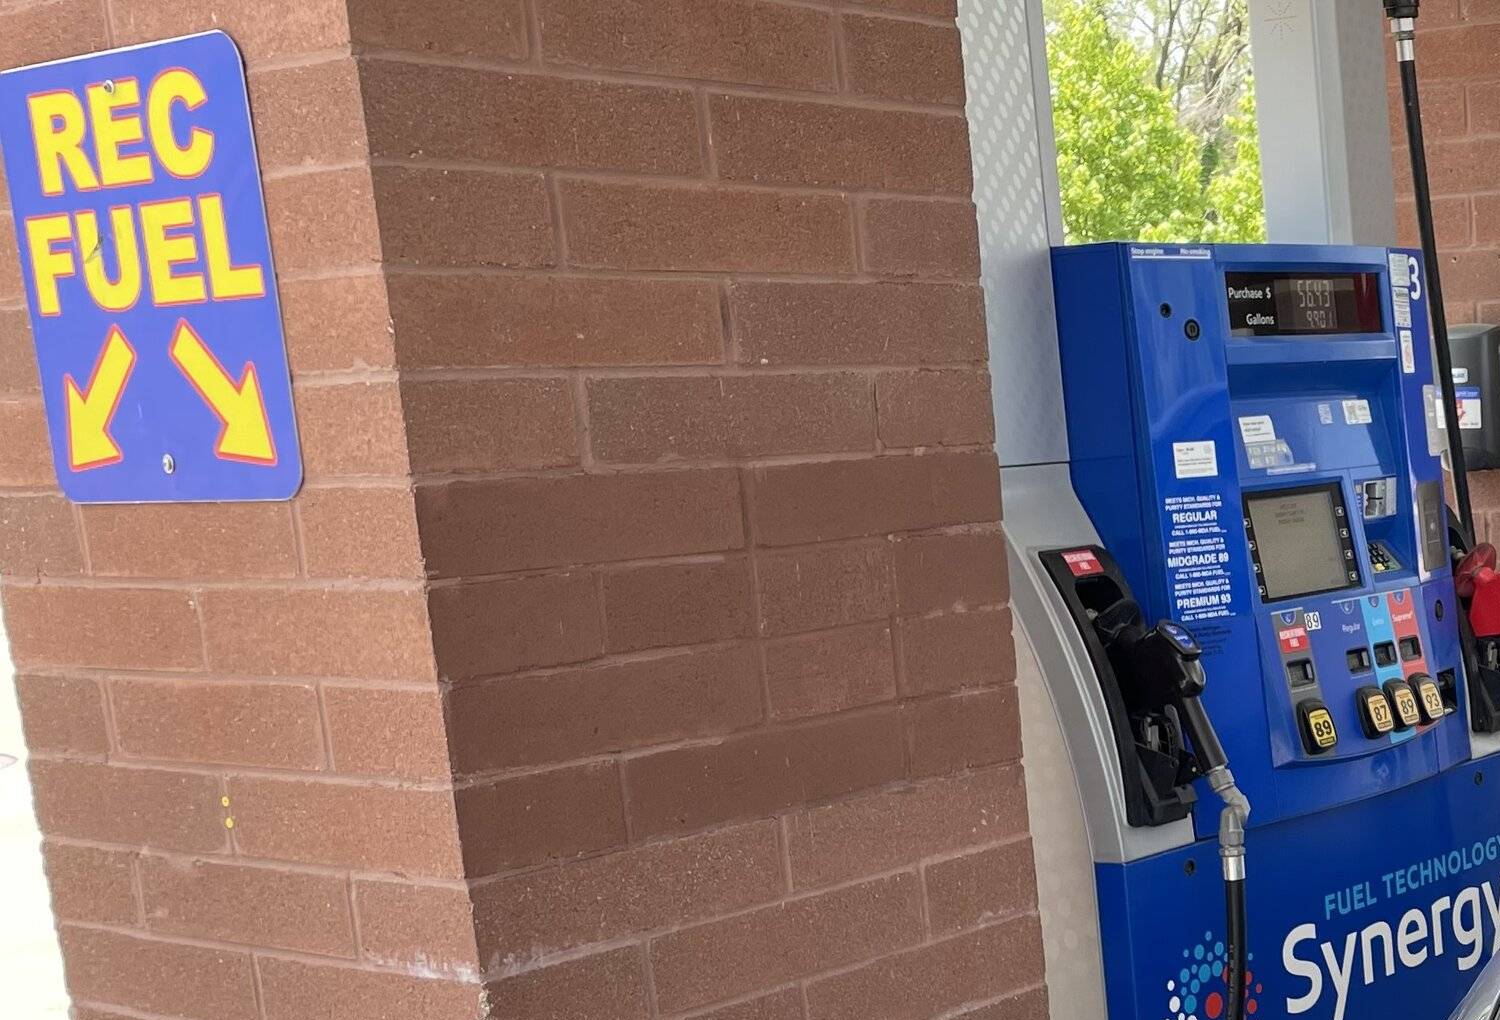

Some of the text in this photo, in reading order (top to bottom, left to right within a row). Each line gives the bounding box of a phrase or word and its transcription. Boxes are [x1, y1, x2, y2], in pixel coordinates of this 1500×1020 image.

[27, 66, 214, 196] REC
[24, 192, 266, 317] FUEL
[1408, 256, 1421, 300] 3
[1228, 286, 1272, 300] Purchase $
[1246, 313, 1275, 325] Gallons
[1173, 511, 1217, 524] REGULAR
[1168, 552, 1229, 568] MIDGRADE 89
[1177, 595, 1220, 610] PREMIUM
[1221, 593, 1232, 604] 93
[1306, 613, 1320, 629] 89
[1400, 698, 1414, 715] 89
[1425, 693, 1440, 708] 93
[1373, 704, 1387, 722] 87
[1314, 719, 1332, 738] 89
[1324, 881, 1377, 920] FUEL
